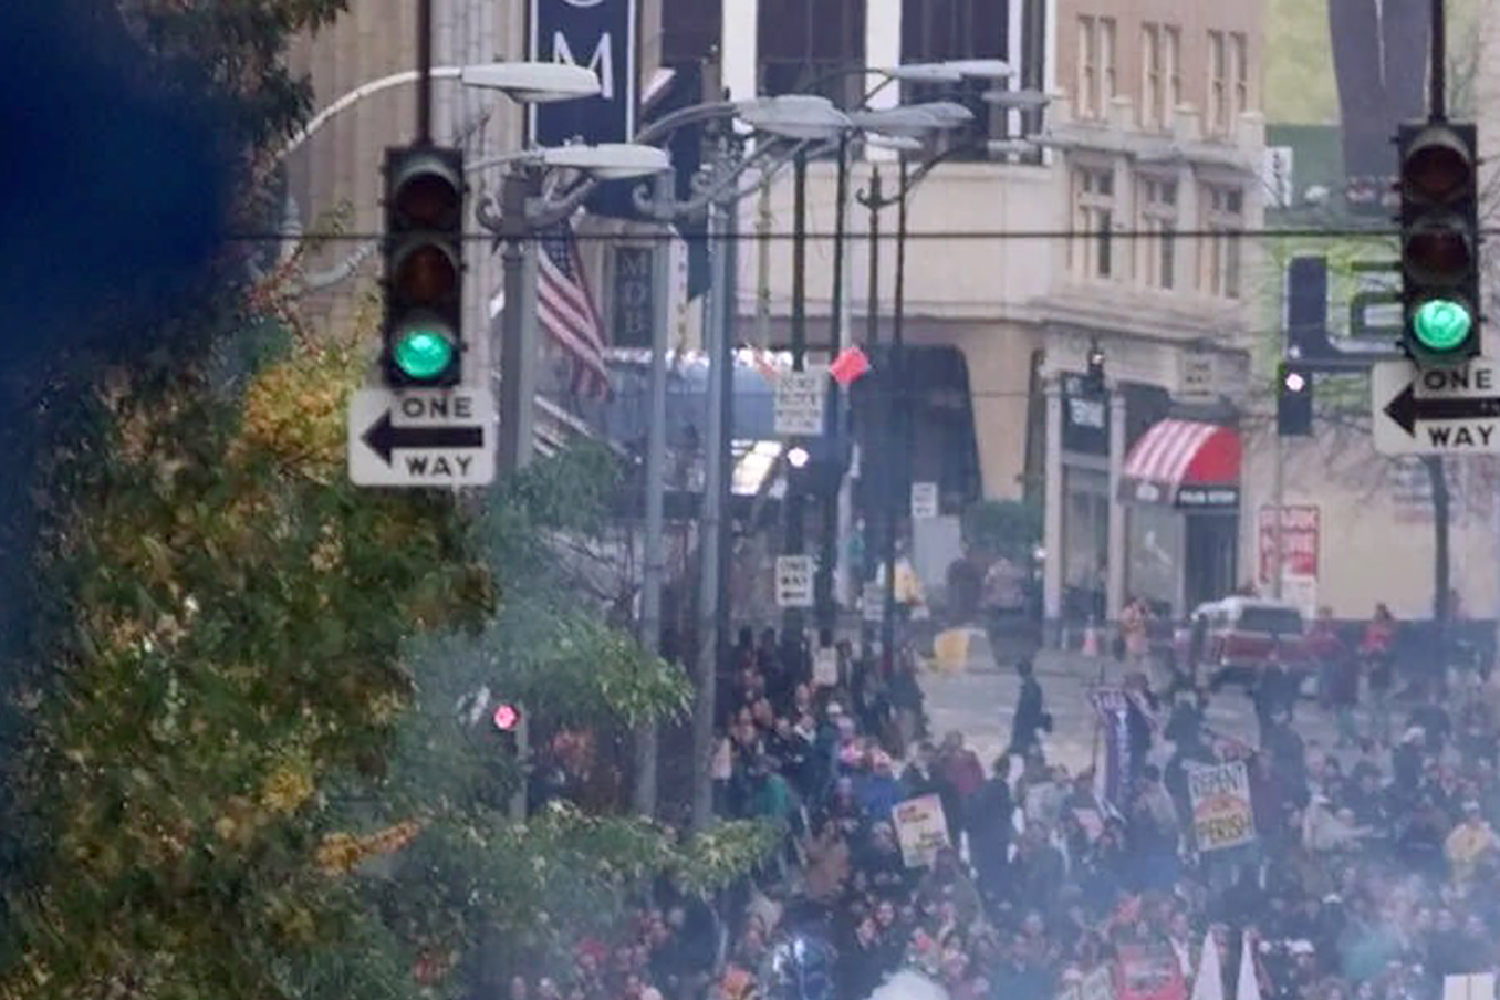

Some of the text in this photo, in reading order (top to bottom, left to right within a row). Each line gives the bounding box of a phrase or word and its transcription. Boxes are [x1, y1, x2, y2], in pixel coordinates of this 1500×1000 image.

[1423, 368, 1493, 390] ONE
[402, 397, 473, 418] ONE
[1427, 425, 1494, 447] WAY
[405, 455, 473, 476] WAY
